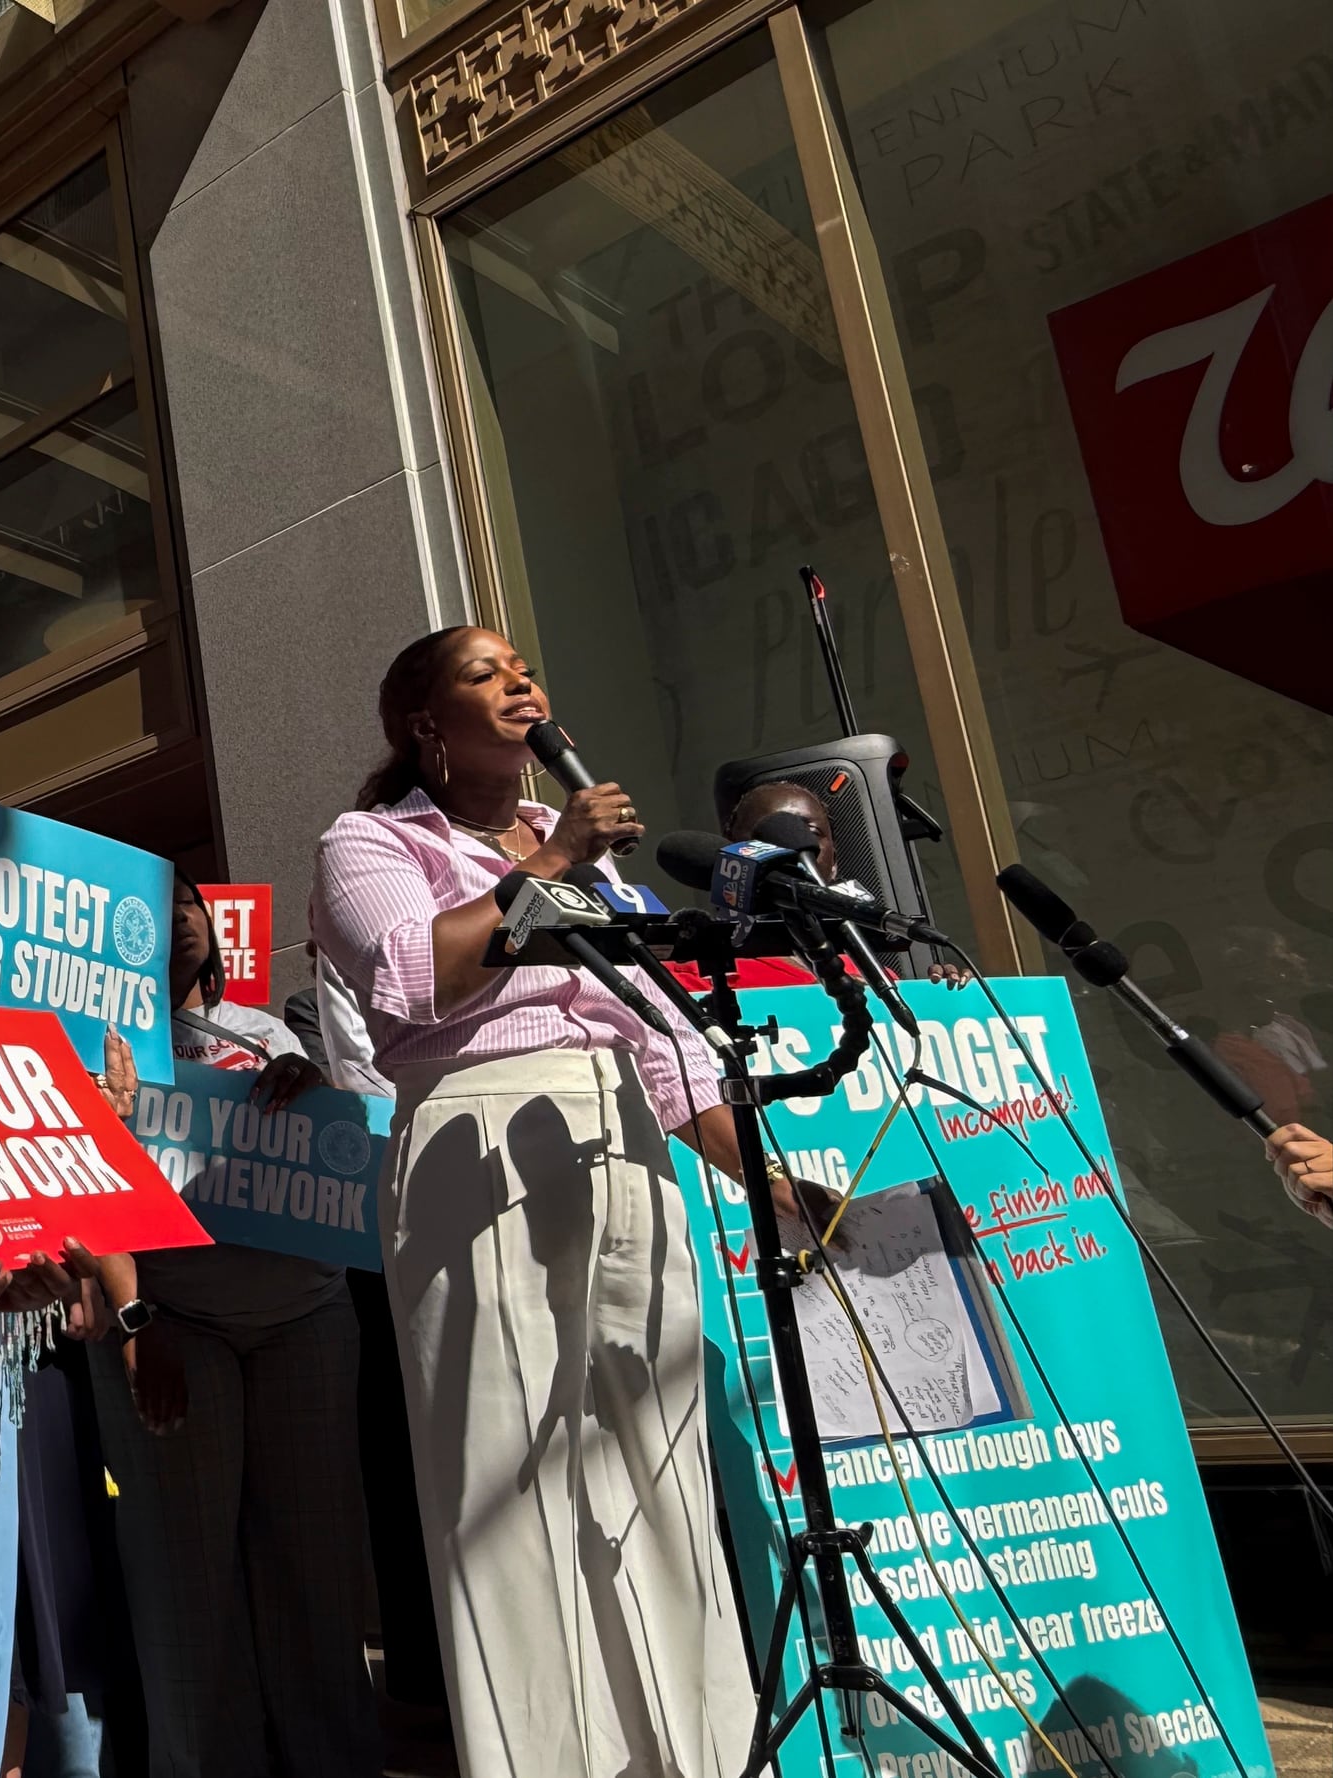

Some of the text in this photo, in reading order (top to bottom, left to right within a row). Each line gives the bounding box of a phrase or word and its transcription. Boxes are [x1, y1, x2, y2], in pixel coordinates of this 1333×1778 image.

[898, 56, 1134, 208] PARK
[1022, 150, 1183, 275] STATE
[612, 882, 647, 914] 9
[720, 857, 742, 880] 5
[13, 943, 156, 1032] STUDENTS
[833, 1015, 1057, 1113] BUDGET
[135, 1086, 194, 1144] DO
[209, 1096, 313, 1165] YOUR
[934, 1074, 1079, 1143] Incomplete!
[696, 1147, 851, 1208] FUING
[988, 1174, 1068, 1239] finish
[1003, 1230, 1074, 1280] back
[1071, 1226, 1107, 1261] in.
[924, 1423, 1052, 1477] furlough
[1053, 1418, 1121, 1462] days
[834, 1478, 1169, 1557] move permanent cuts
[877, 1552, 985, 1603] school
[984, 1539, 1098, 1590] staffing
[857, 1625, 943, 1675] Avod
[1079, 1598, 1166, 1645] freeze
[902, 1669, 1038, 1721] sevices
[1124, 1696, 1223, 1759] Special
